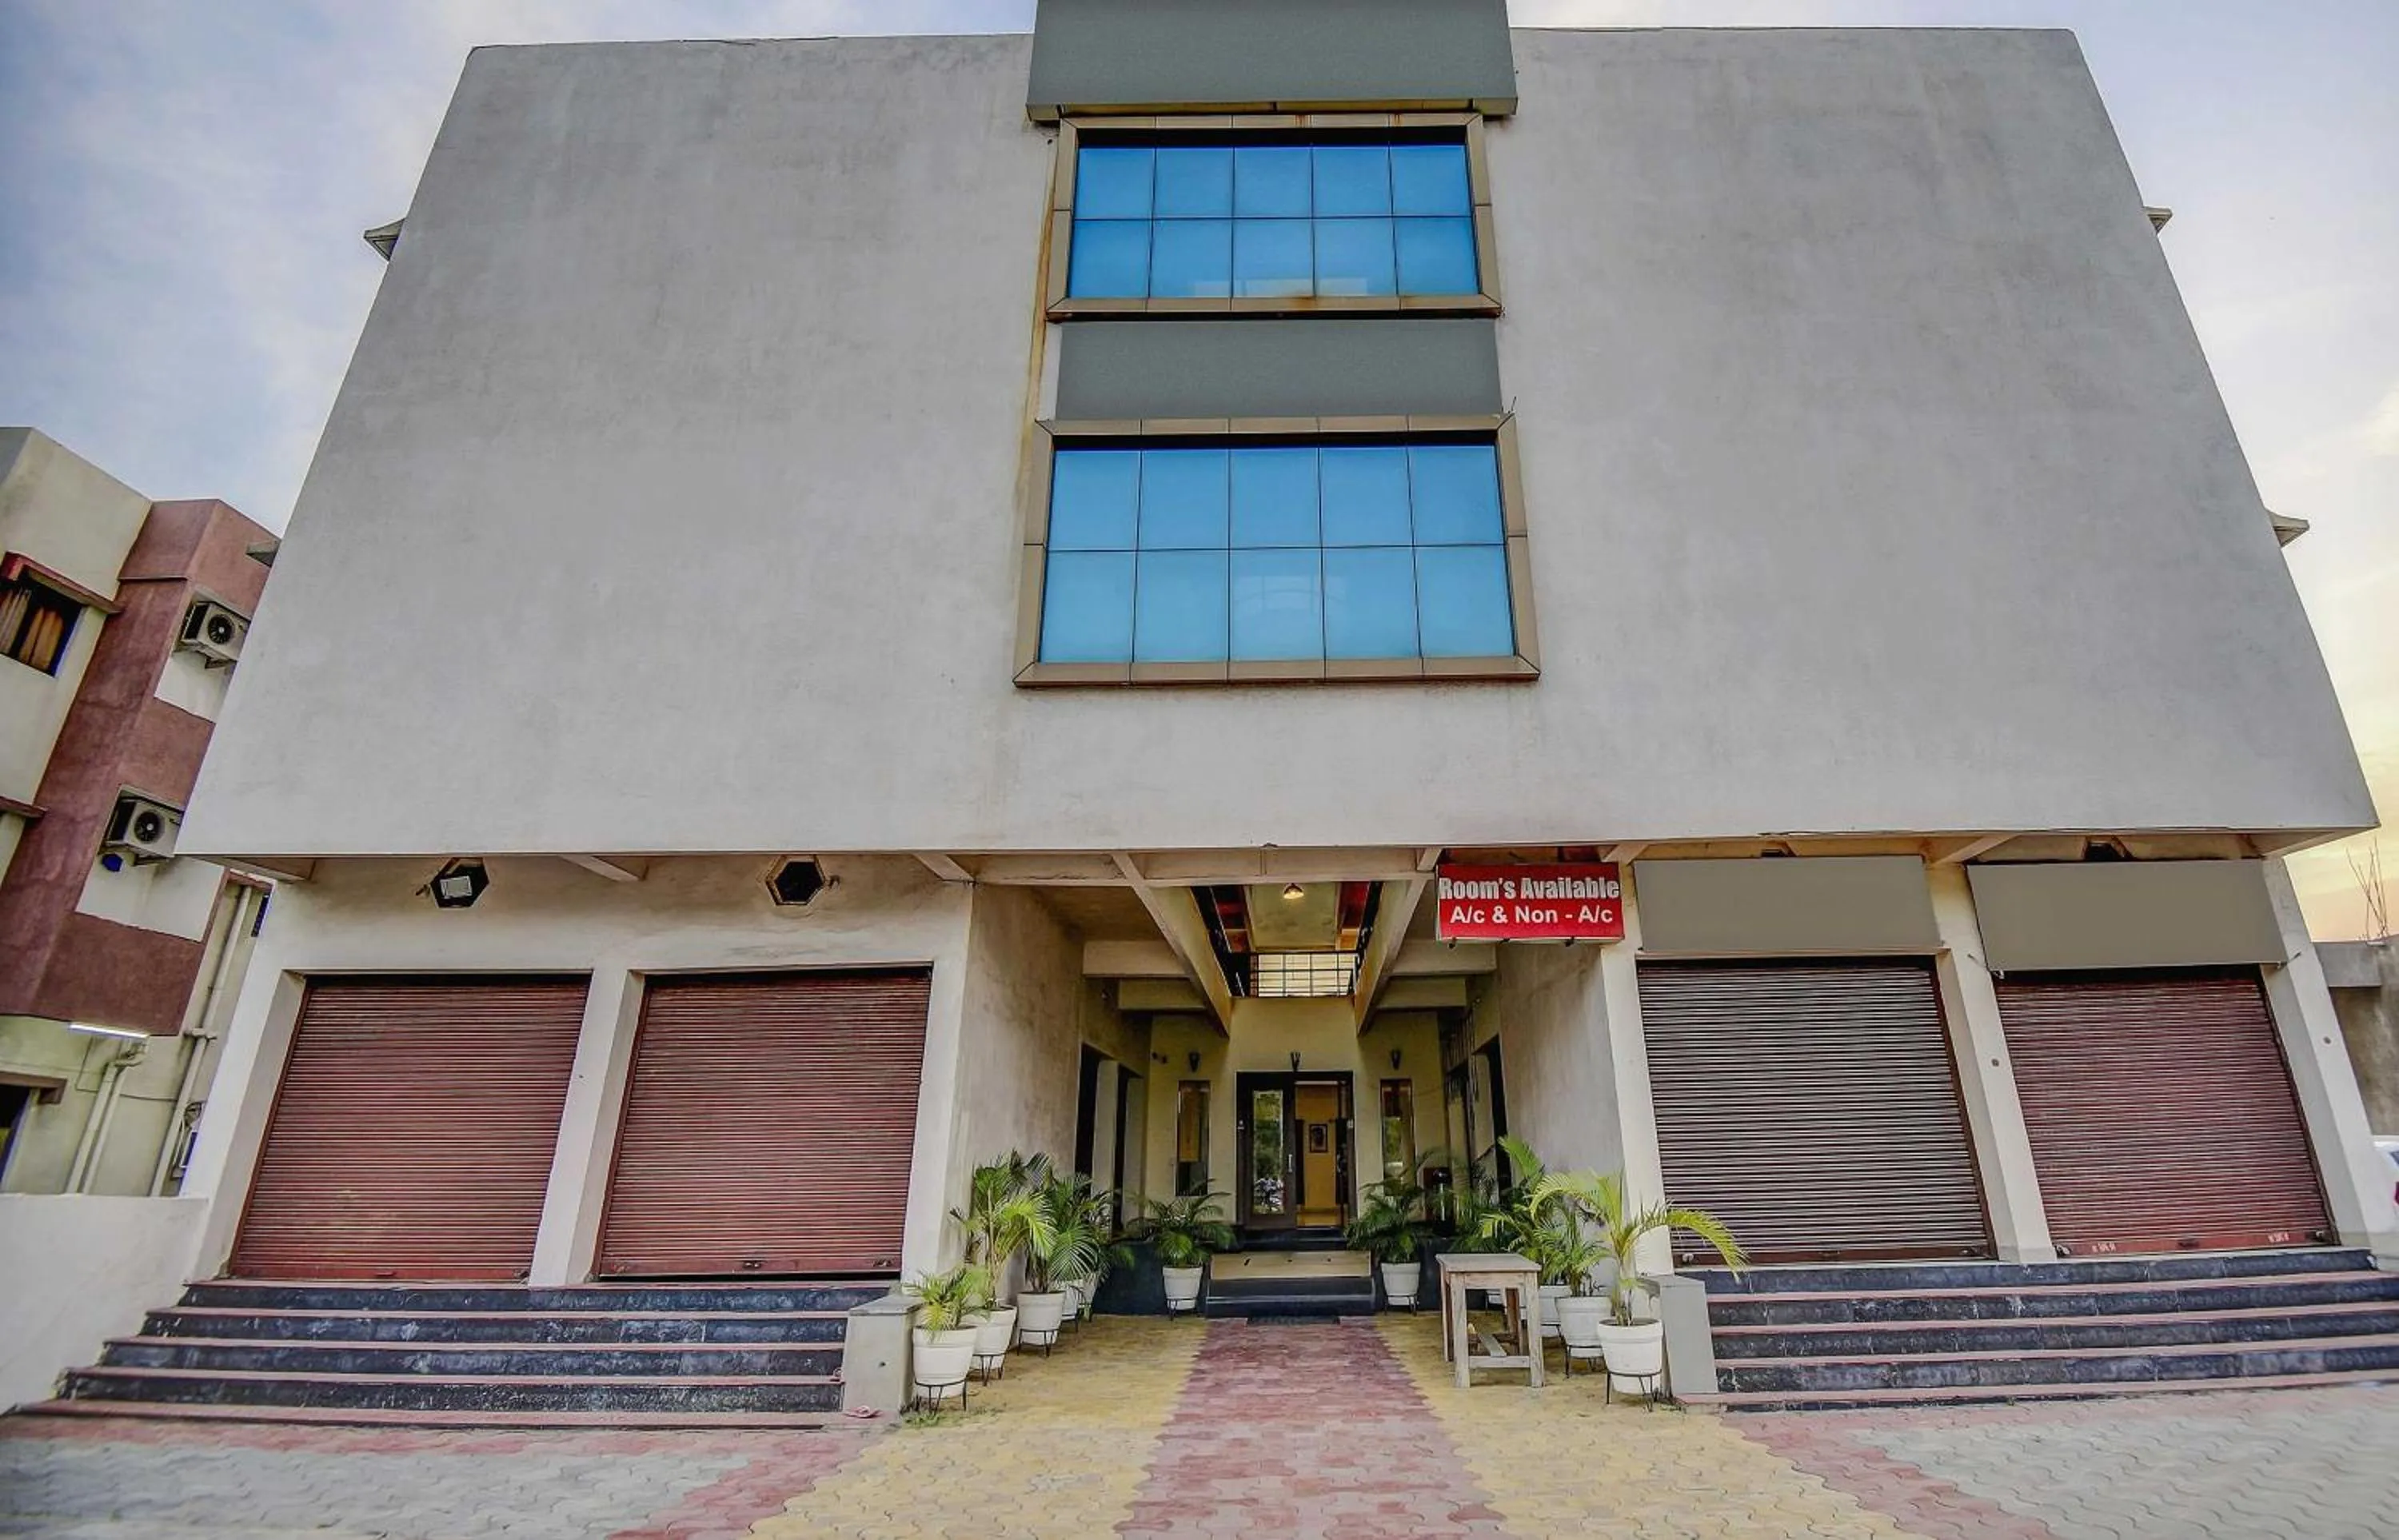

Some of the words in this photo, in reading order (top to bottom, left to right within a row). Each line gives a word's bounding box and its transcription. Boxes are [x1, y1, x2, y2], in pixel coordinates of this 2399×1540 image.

[1439, 877, 1515, 900] Room's
[1521, 876, 1619, 900] Available
[1450, 905, 1485, 924] A/c
[1491, 905, 1509, 924] &
[1515, 905, 1558, 924] Non
[1578, 904, 1613, 924] A/c
